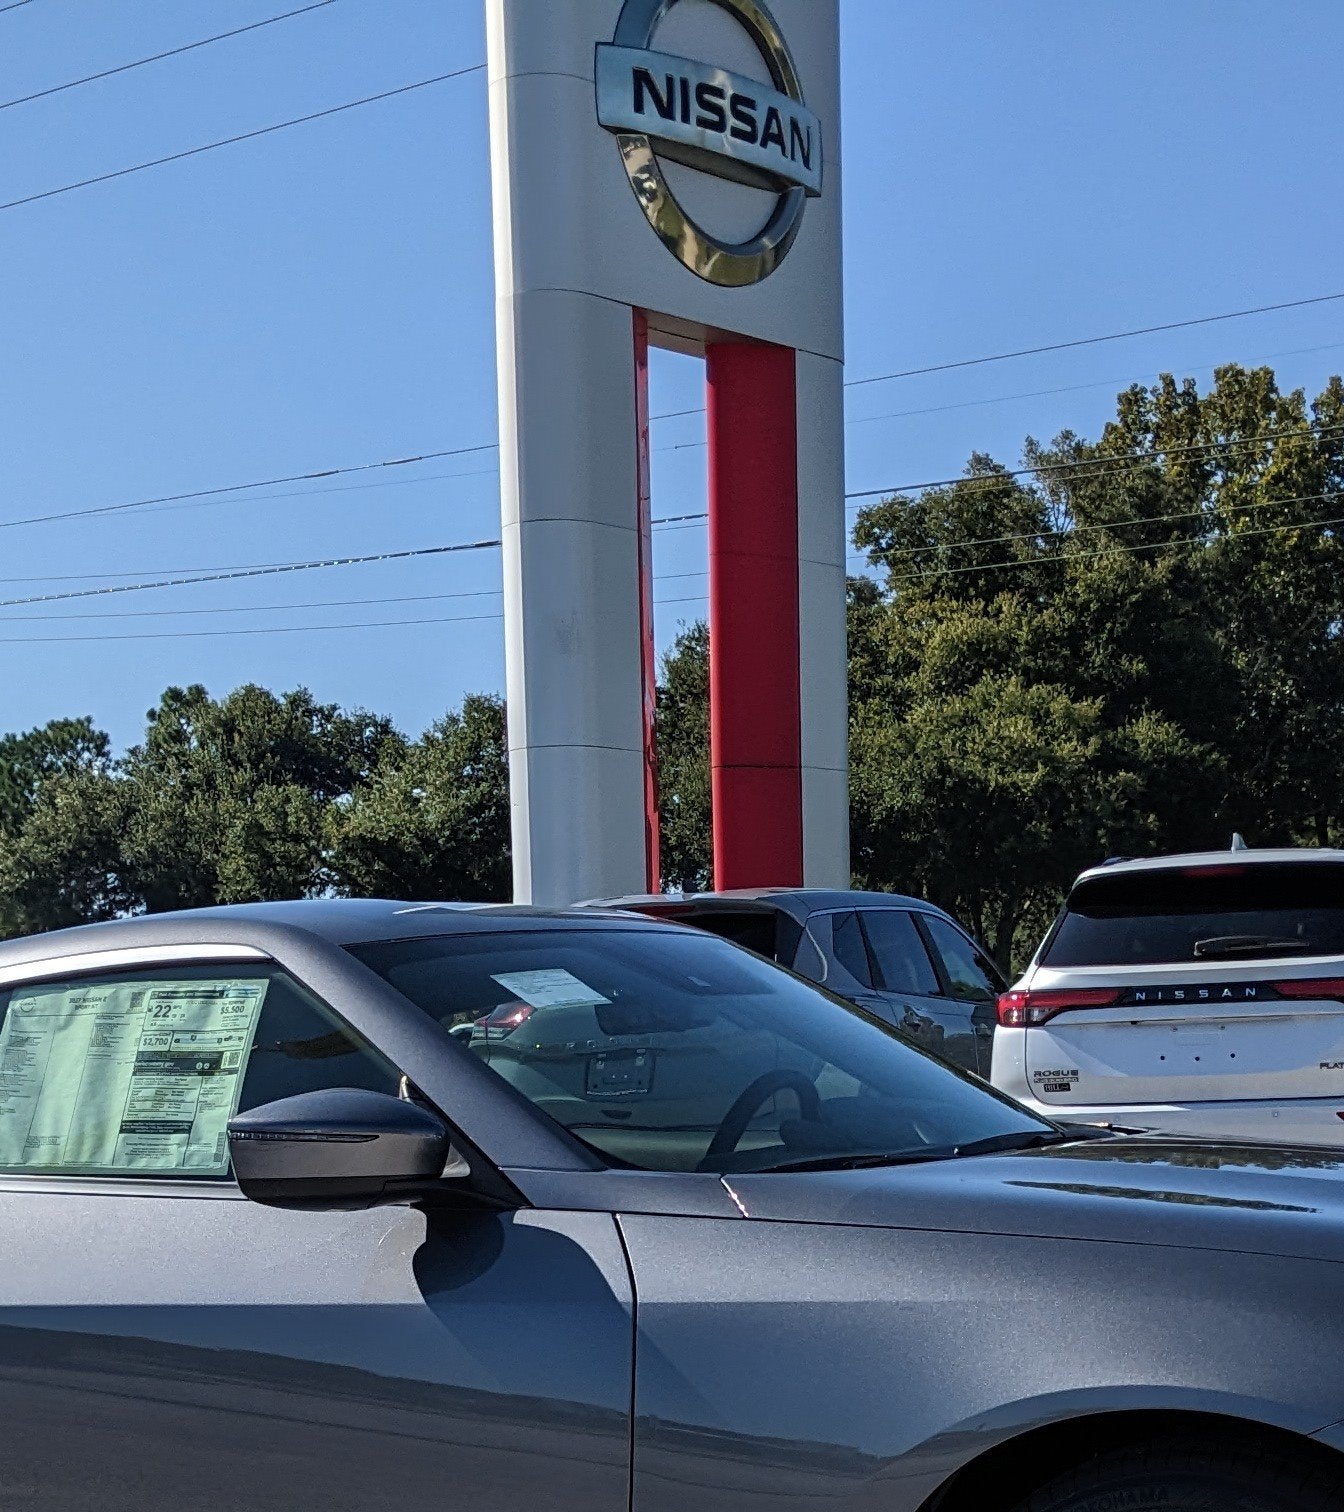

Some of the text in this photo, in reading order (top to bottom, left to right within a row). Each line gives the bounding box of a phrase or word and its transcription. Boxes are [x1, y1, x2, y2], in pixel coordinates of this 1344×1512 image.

[631, 66, 812, 171] NISSAN
[1136, 987, 1256, 1001] NISSAN
[153, 1004, 172, 1018] 22
